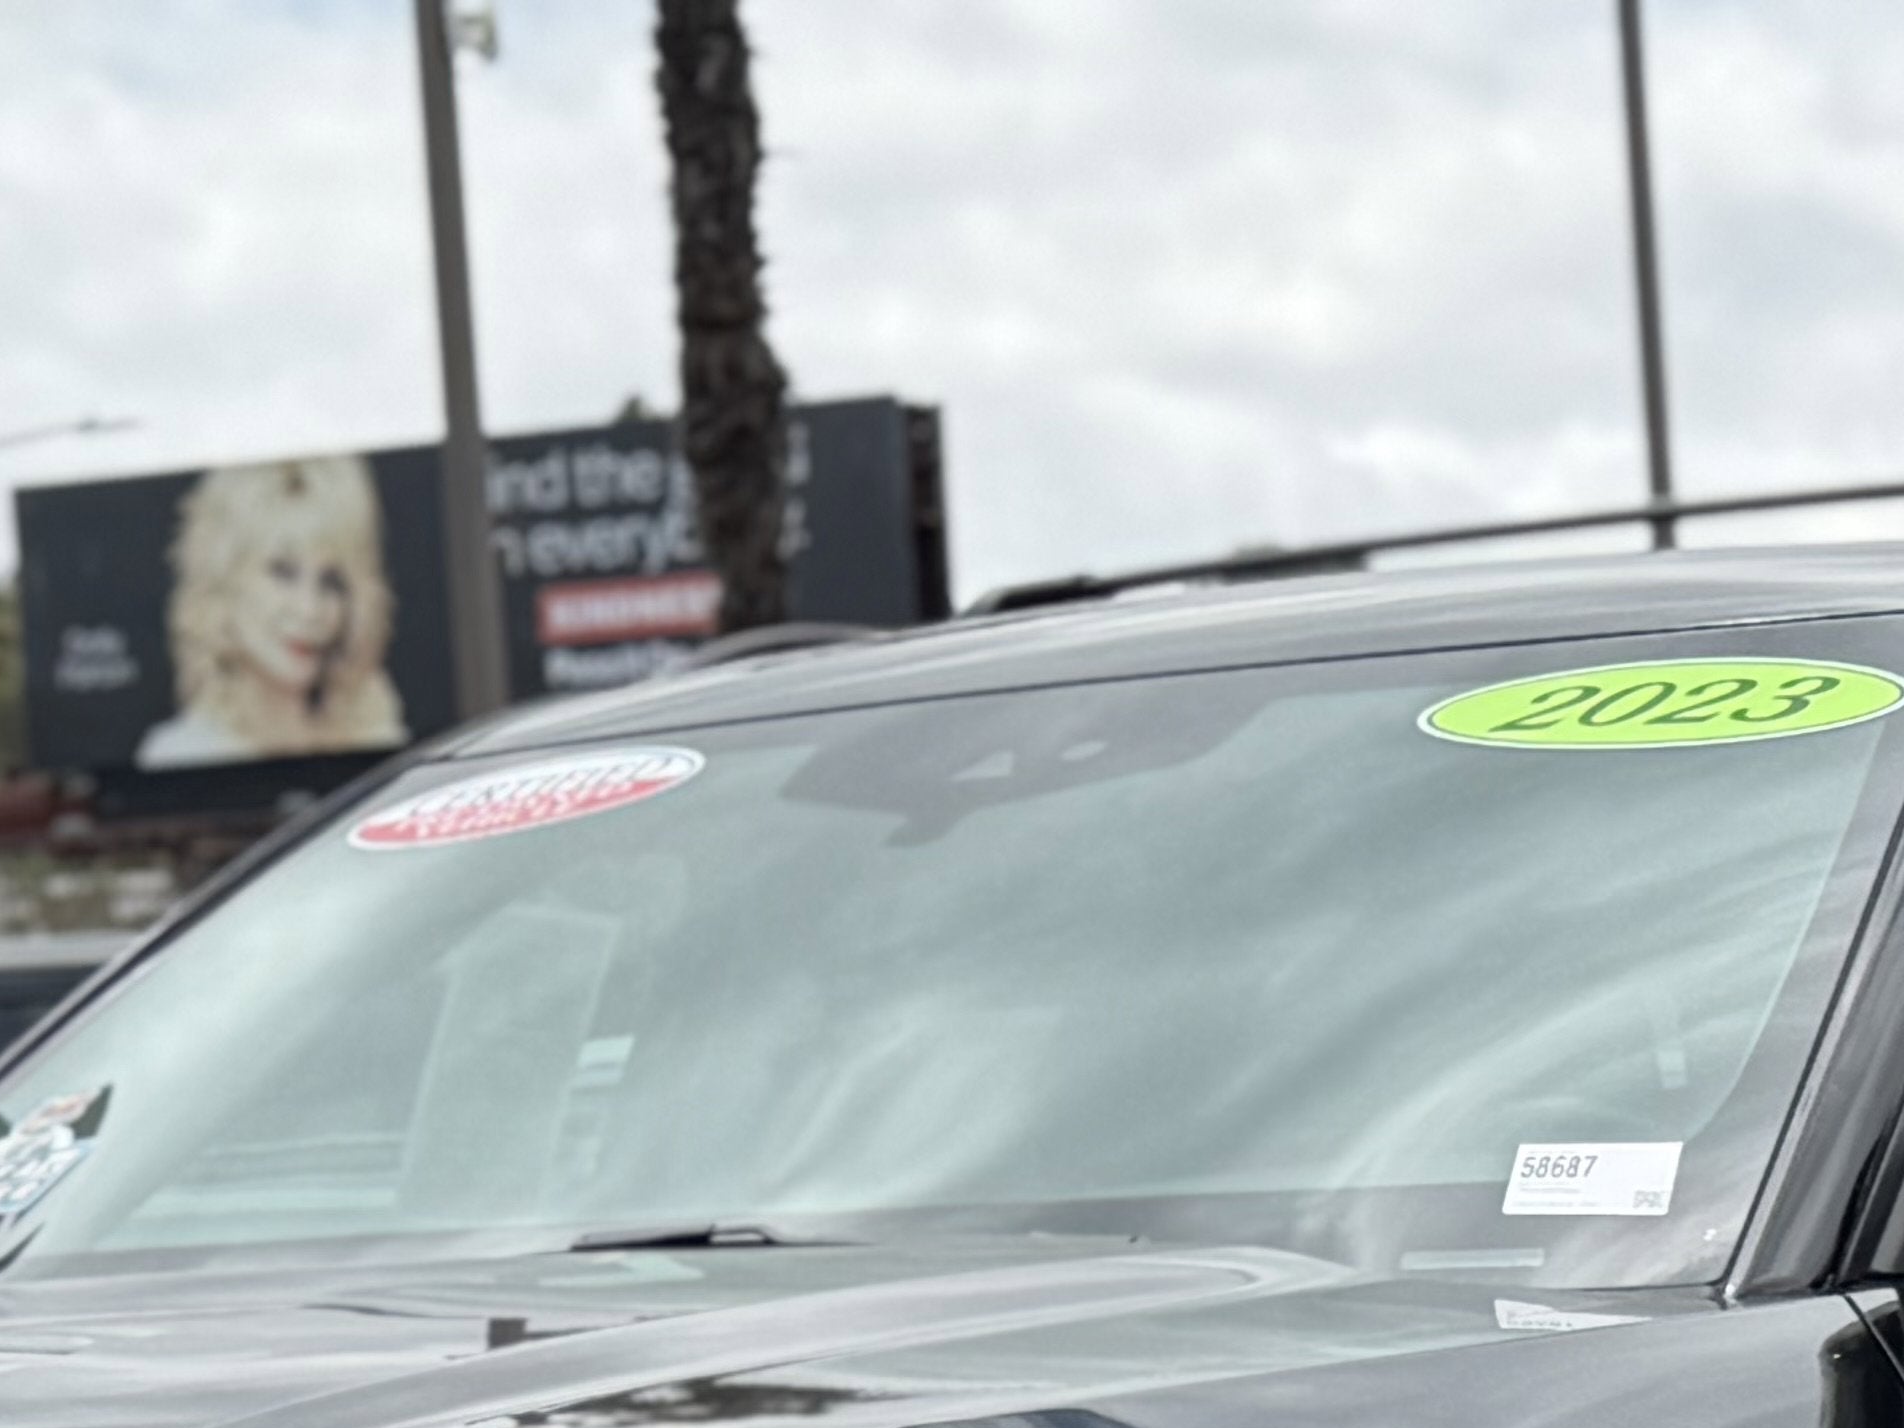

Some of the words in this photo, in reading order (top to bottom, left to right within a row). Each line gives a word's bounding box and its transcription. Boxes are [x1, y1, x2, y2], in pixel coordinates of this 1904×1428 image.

[486, 446, 566, 512] ind
[571, 445, 664, 508] the
[1486, 674, 1843, 734] 2023
[1519, 1155, 1599, 1179] 58687
